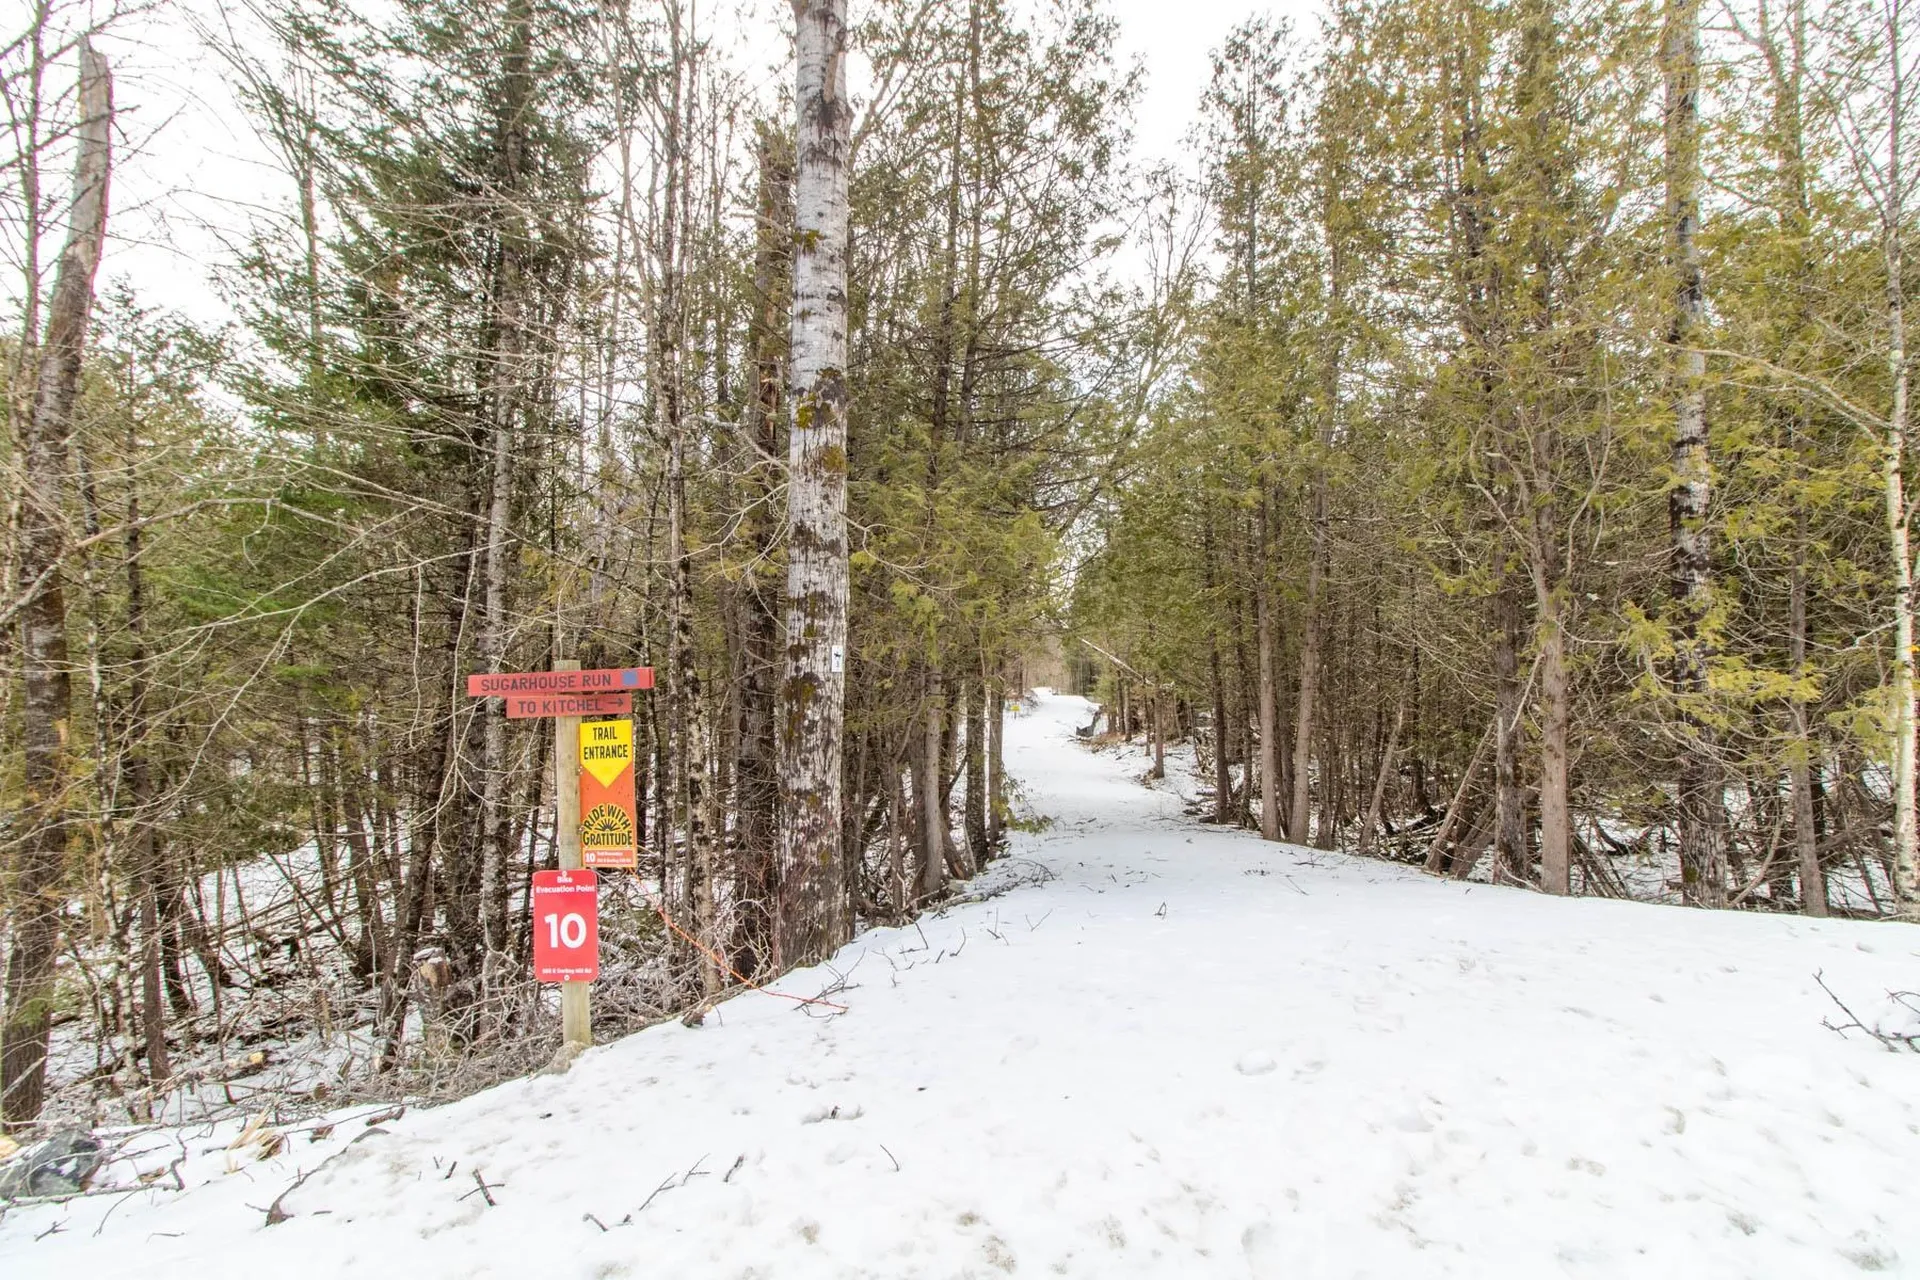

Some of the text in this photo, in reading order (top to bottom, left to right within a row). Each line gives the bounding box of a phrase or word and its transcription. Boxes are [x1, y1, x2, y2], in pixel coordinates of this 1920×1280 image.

[481, 673, 612, 692] SUGARHOUSE RUN
[518, 698, 603, 715] TO KITCHEL
[592, 726, 618, 740] TRAIL
[583, 744, 629, 760] ENTRANCE
[584, 804, 631, 831] RIDE WITH
[582, 830, 633, 846] GRATITUDE
[585, 852, 596, 863] 10
[544, 912, 588, 949] 10
